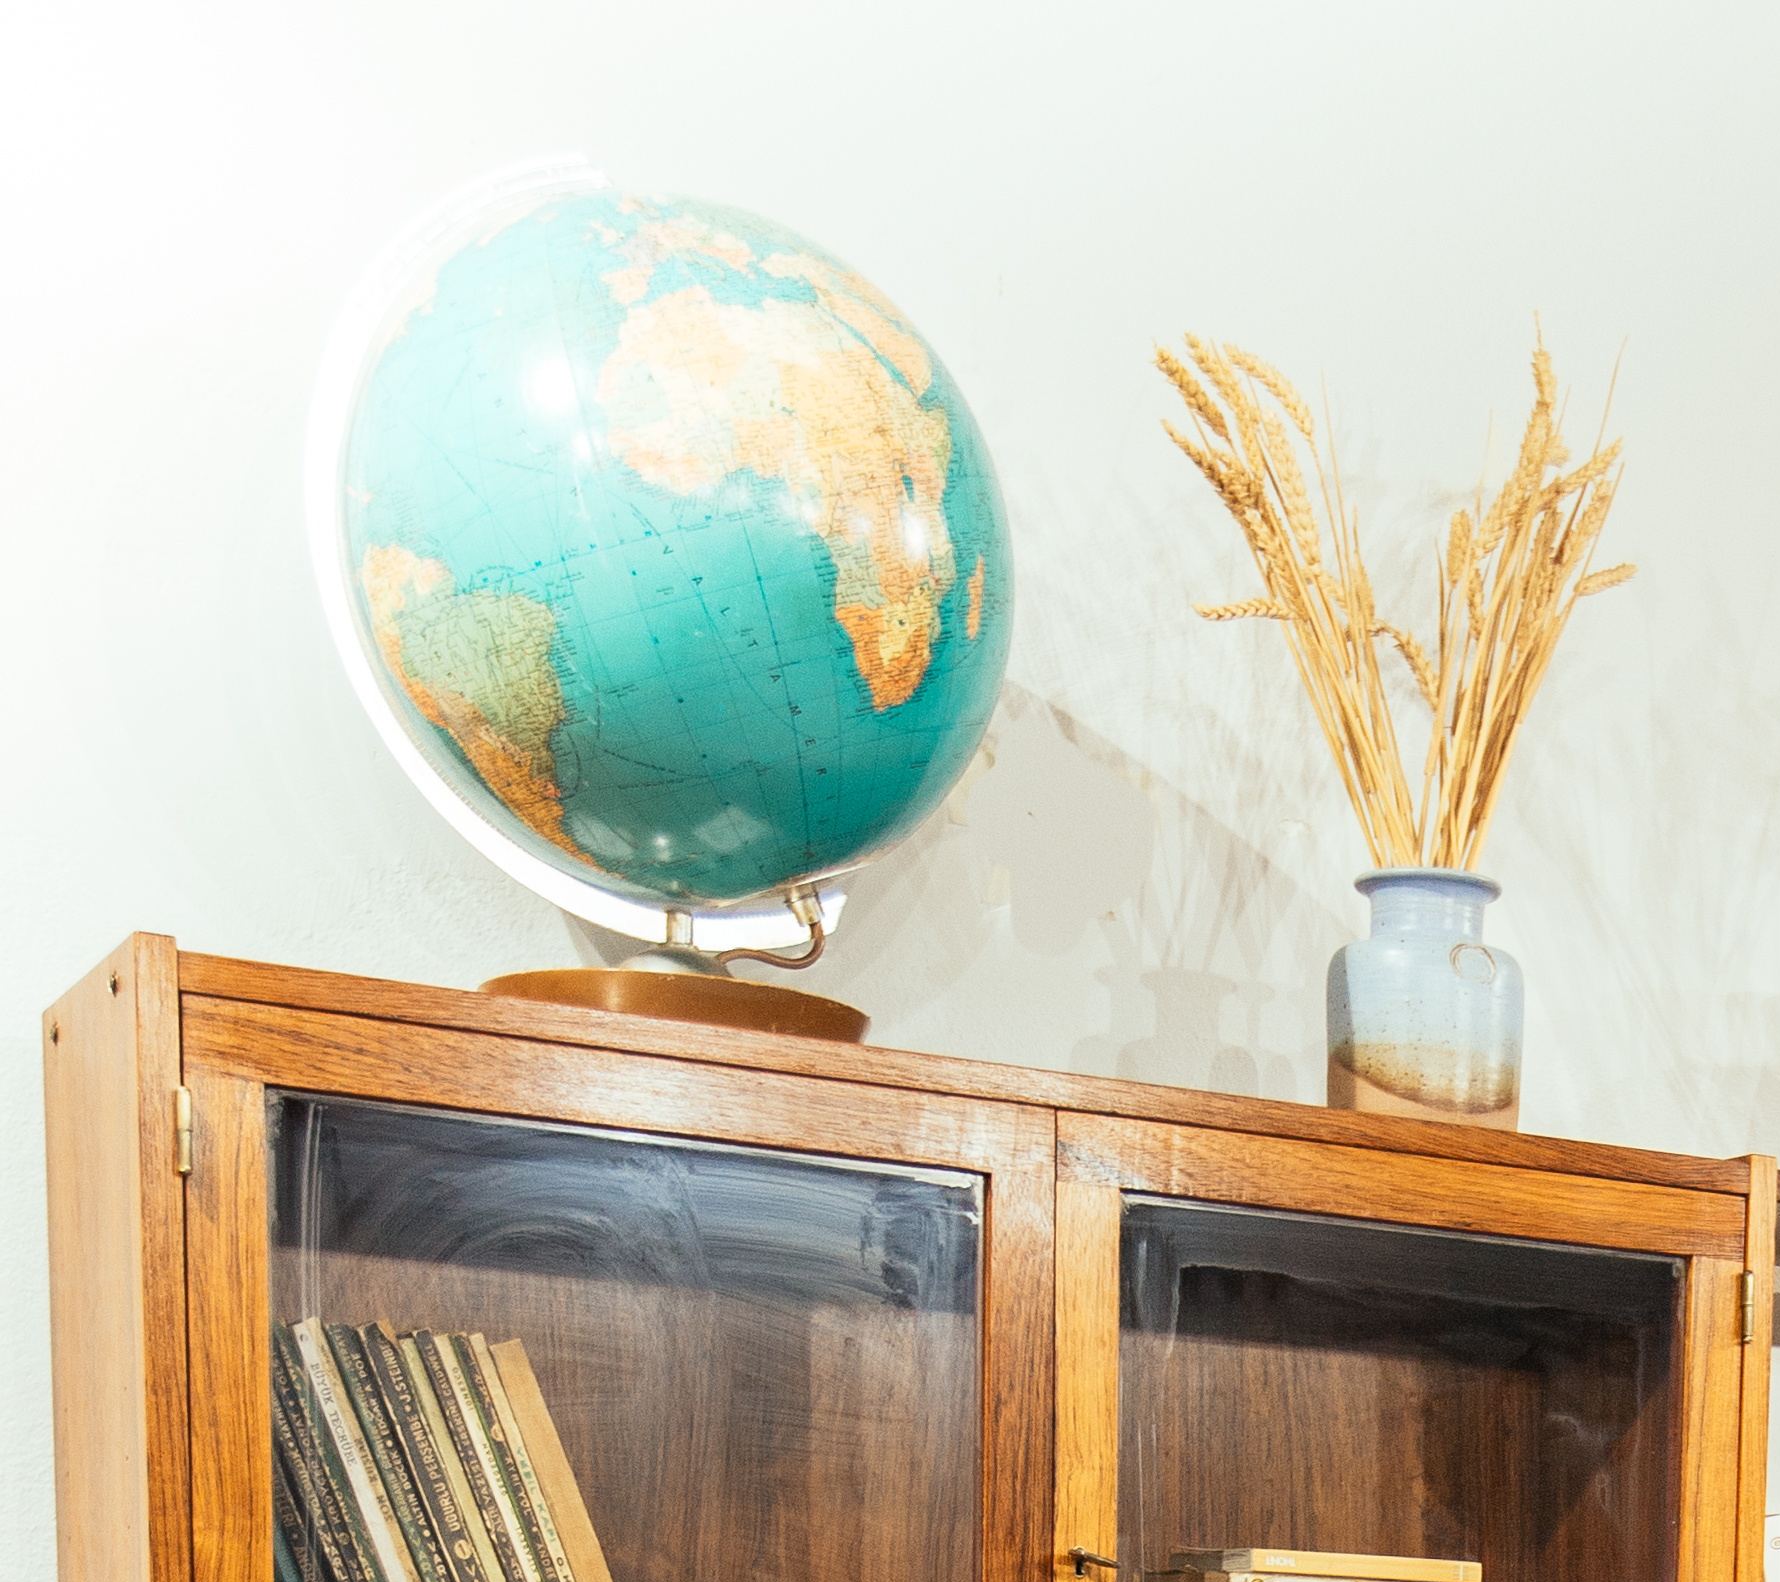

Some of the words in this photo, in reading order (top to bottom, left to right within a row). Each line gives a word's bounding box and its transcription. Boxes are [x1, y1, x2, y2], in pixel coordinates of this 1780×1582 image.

[363, 1383, 373, 1392] A
[309, 1360, 336, 1405] BÜYÜK
[327, 1408, 359, 1467] TECRÜBE
[368, 1397, 390, 1436] EDGAR
[405, 1412, 442, 1480] PERŞEMBE
[407, 1492, 426, 1527] ALTIN
[1265, 1554, 1296, 1566] THONET
